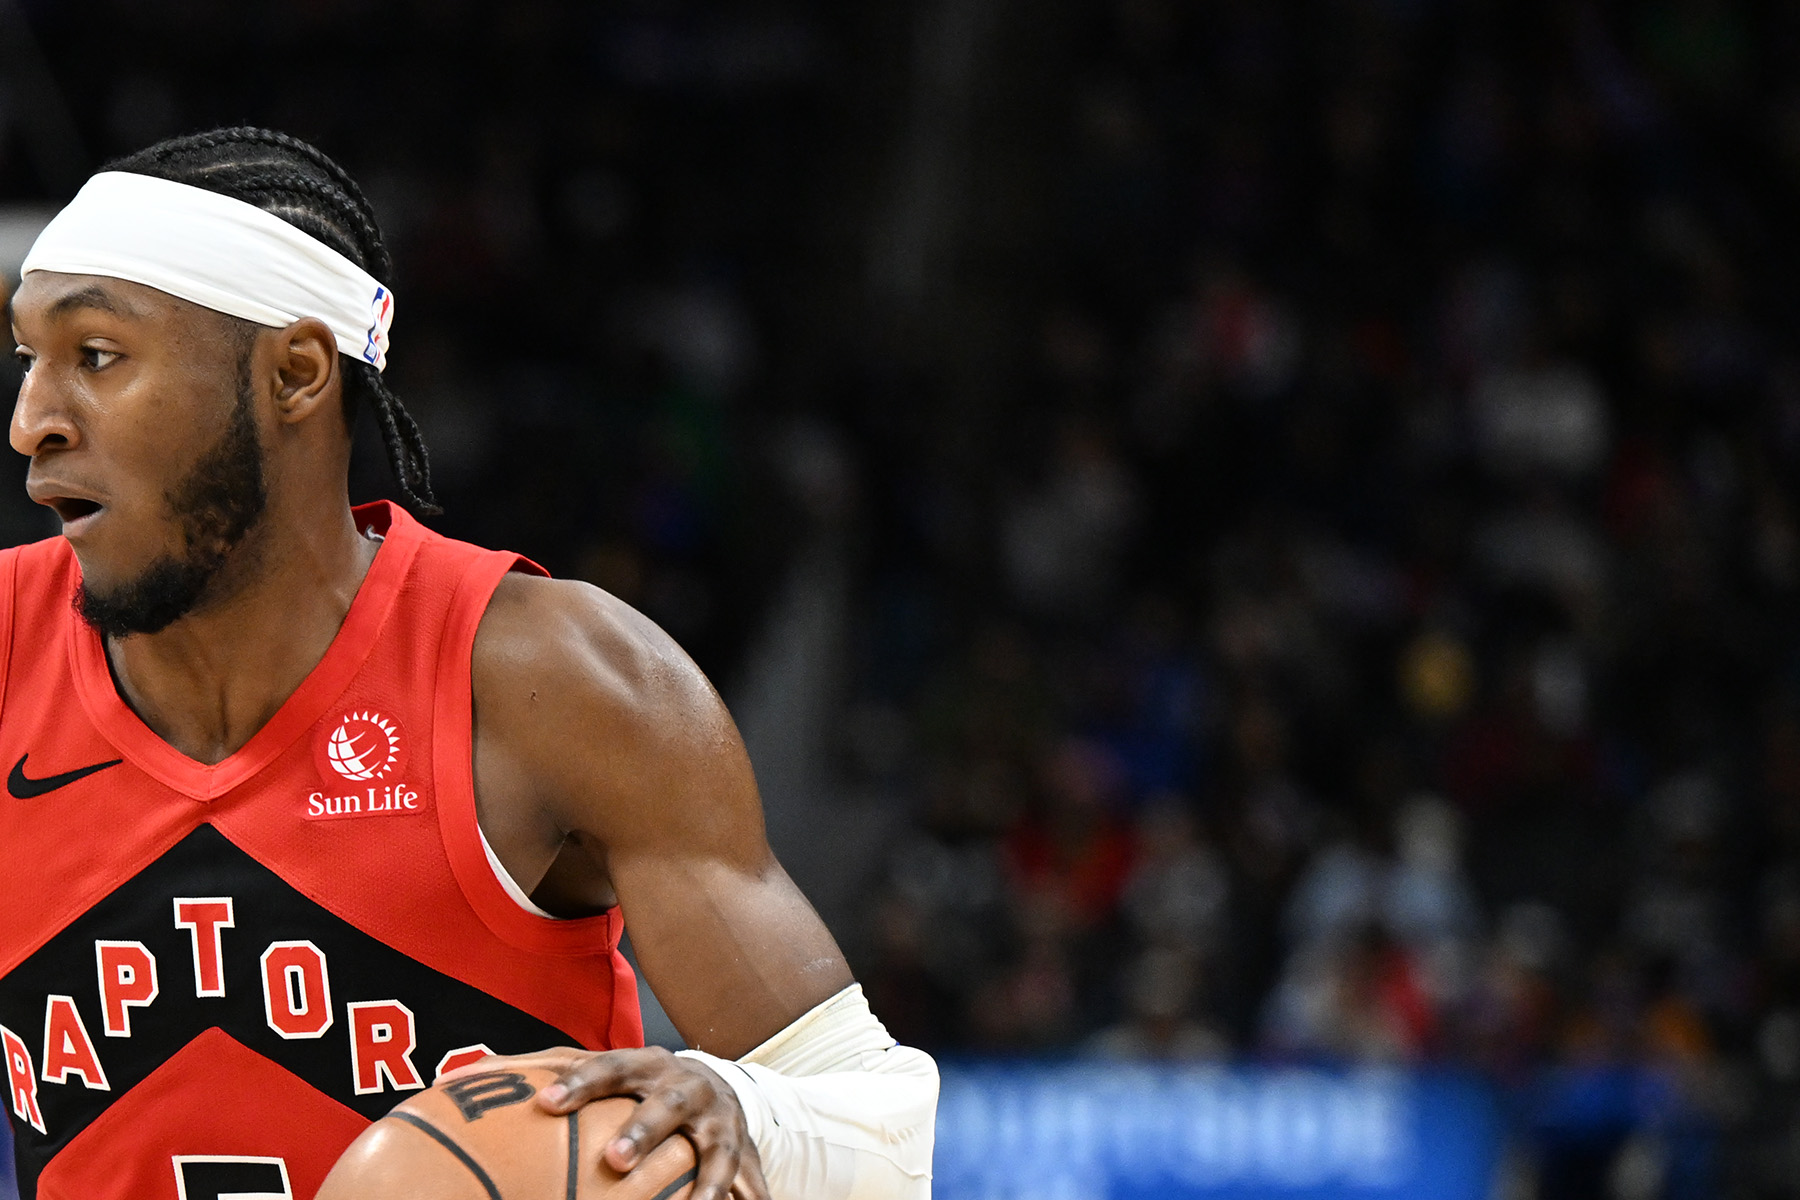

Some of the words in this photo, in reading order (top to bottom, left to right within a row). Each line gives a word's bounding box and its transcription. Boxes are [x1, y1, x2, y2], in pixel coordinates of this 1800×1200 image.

[308, 792, 361, 816] Sun
[367, 784, 418, 811] Life
[0, 897, 497, 1134] RAPTOR
